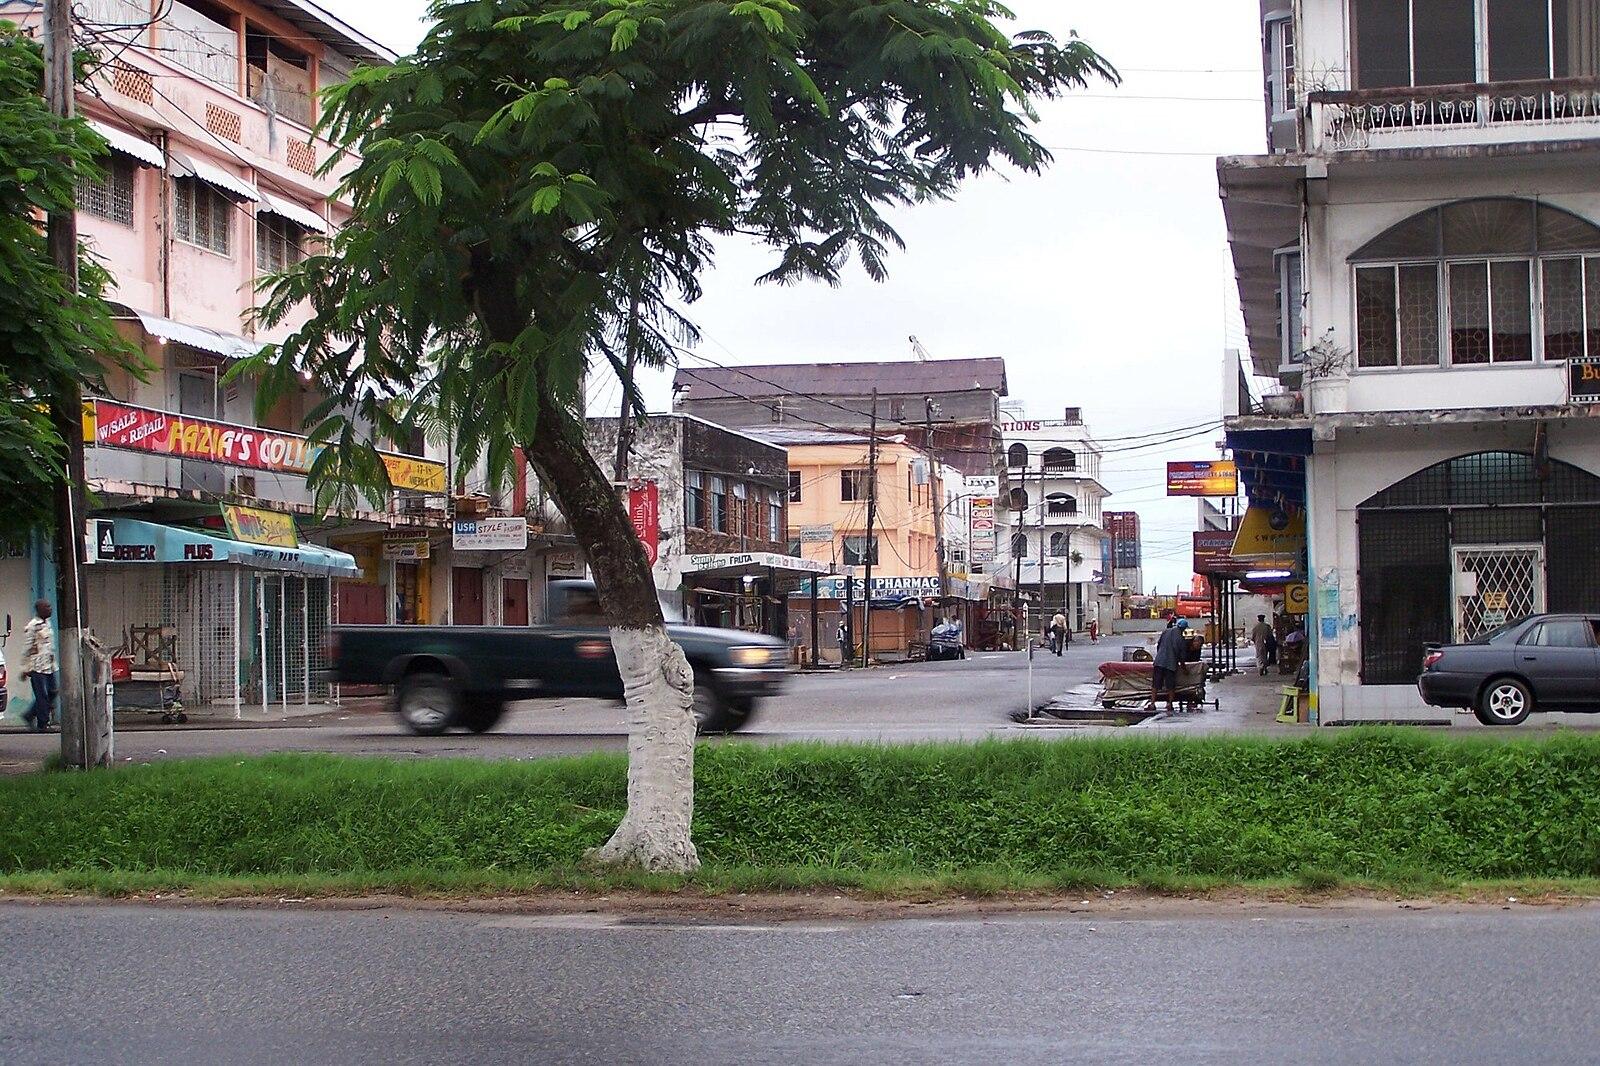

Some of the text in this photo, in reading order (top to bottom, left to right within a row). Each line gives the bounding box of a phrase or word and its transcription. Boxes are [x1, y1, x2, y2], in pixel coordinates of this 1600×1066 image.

[98, 411, 138, 439] W/SALE
[120, 417, 164, 444] & RETAIL
[1001, 421, 1040, 432] TIONS
[168, 421, 254, 461] FAZIA'S
[457, 522, 475, 532] USA
[184, 544, 213, 560] PLUS
[729, 554, 753, 565] FRUTA
[876, 578, 939, 589] PHARMAC
